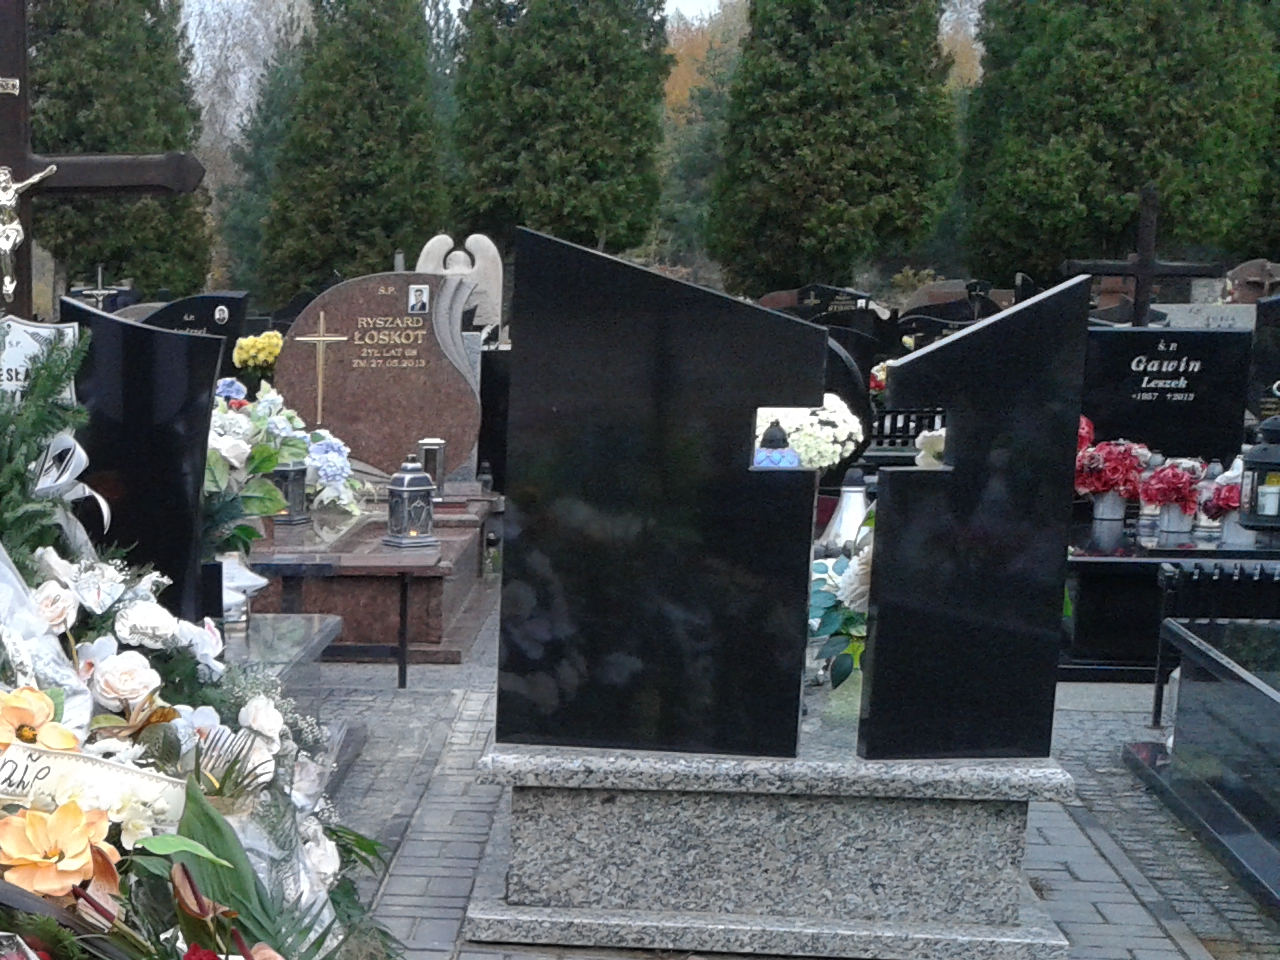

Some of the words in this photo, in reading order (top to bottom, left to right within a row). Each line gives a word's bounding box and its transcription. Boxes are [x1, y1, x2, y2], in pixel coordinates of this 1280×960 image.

[357, 316, 424, 328] RYSZARD
[353, 330, 427, 345] ŁOSKOT
[1131, 355, 1202, 372] Gawin
[1141, 376, 1188, 388] Leszek
